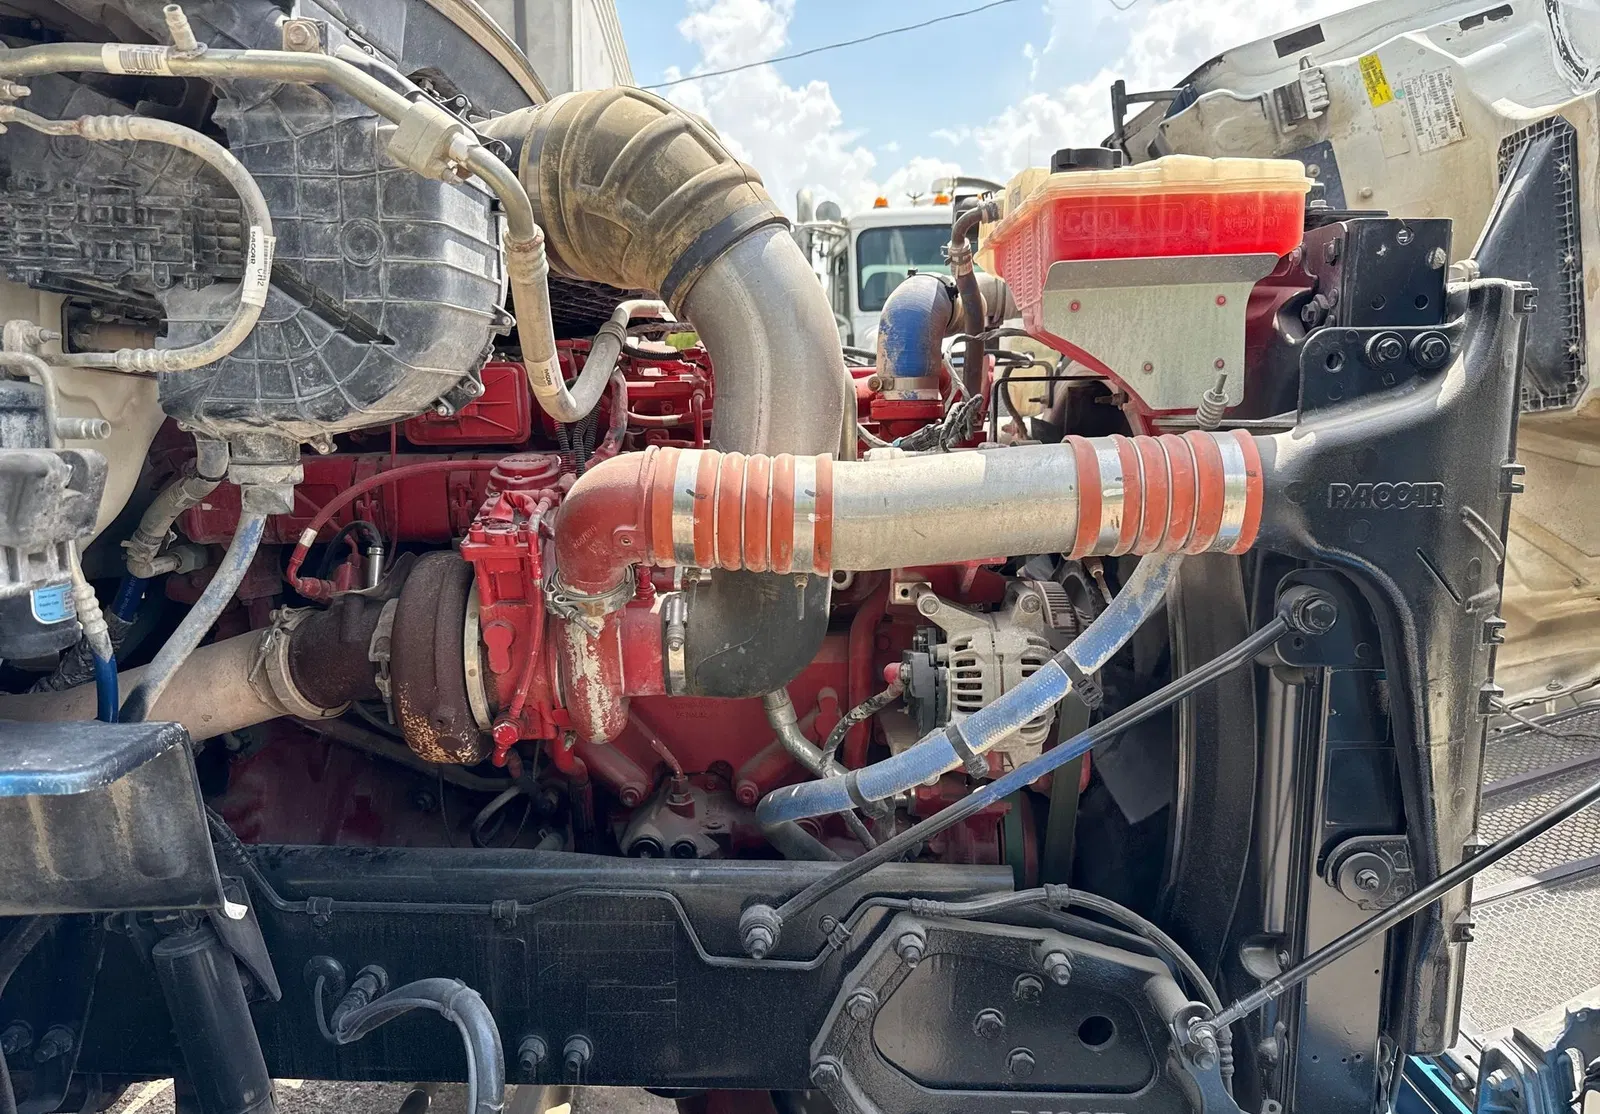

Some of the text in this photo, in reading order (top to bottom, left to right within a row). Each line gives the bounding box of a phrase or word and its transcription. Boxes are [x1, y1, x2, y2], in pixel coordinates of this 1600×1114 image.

[1224, 203, 1300, 216] DO NOT OPEN
[1064, 207, 1179, 235] COOLANT
[1223, 216, 1254, 228] WHEN
[1327, 481, 1445, 510] PACCAR
